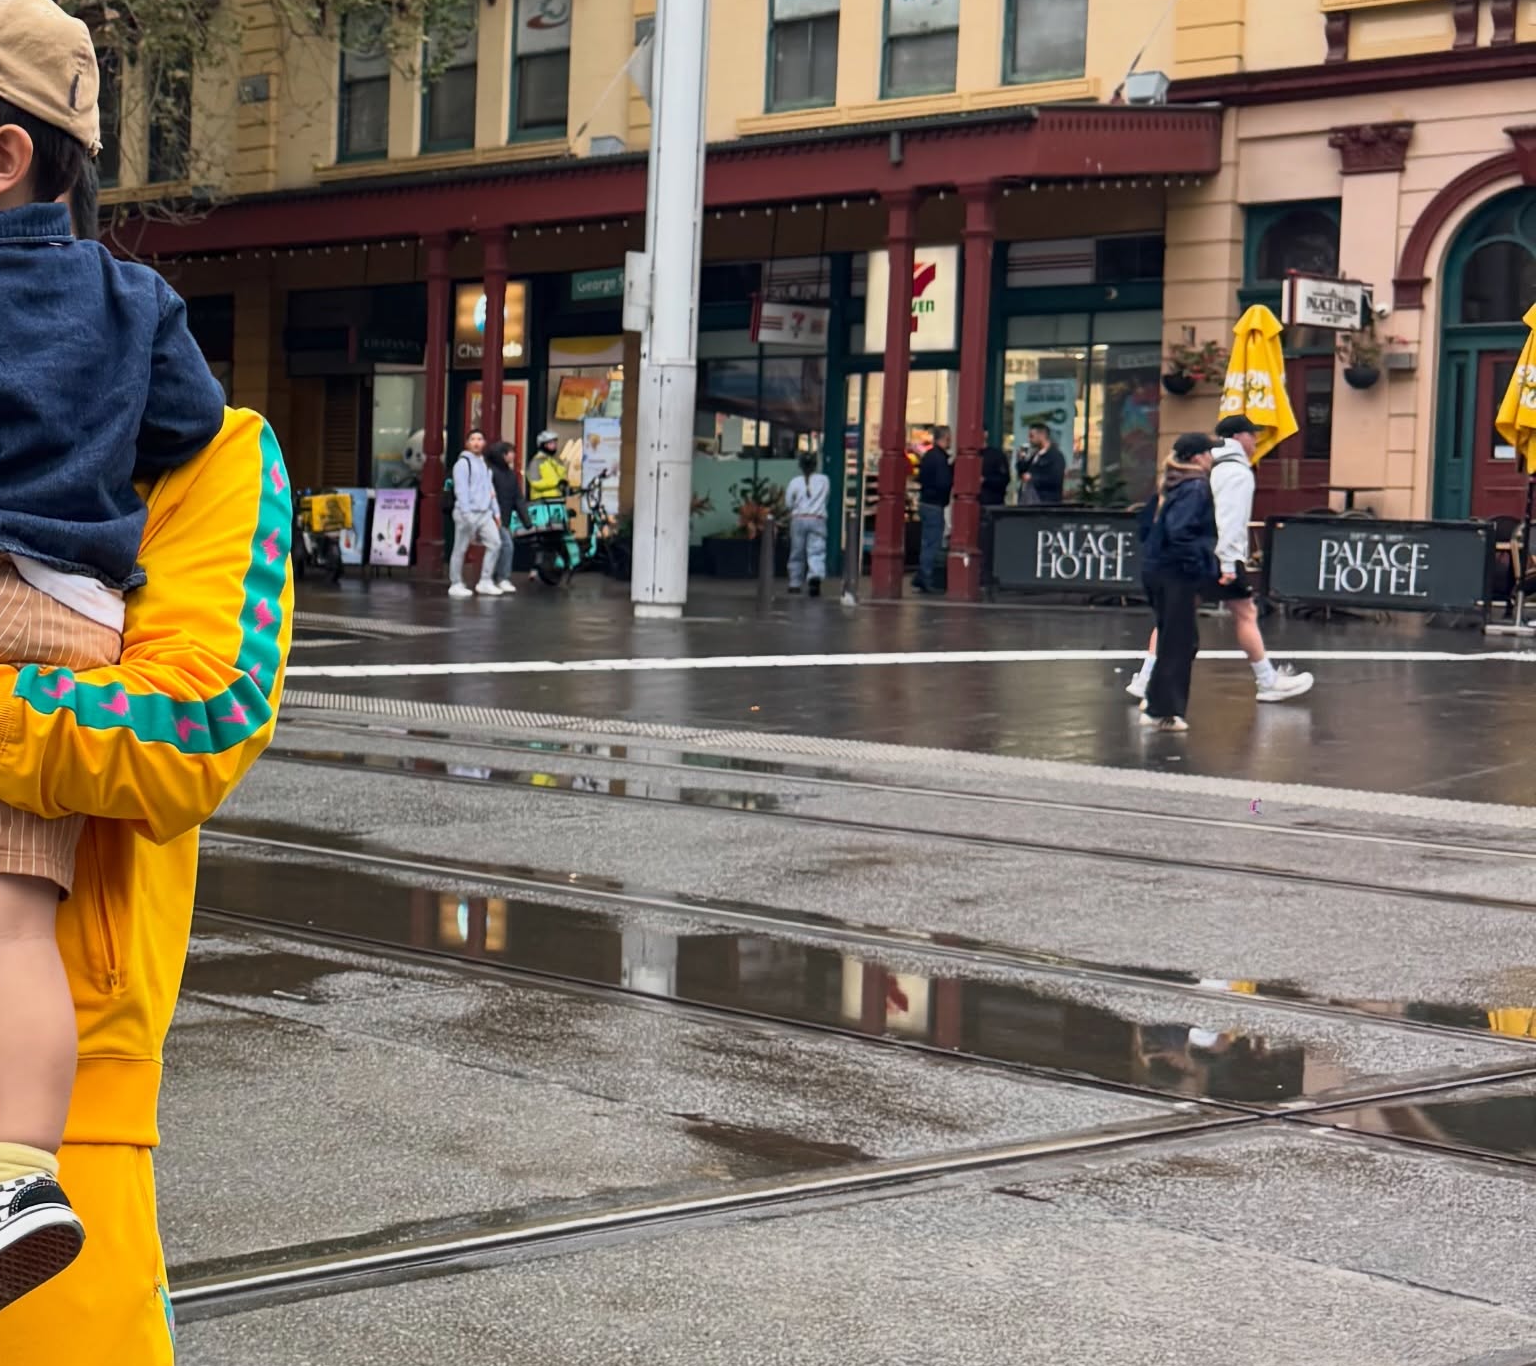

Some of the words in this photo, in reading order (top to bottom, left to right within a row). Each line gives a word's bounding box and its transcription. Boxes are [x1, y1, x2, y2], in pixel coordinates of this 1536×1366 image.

[577, 276, 617, 295] George
[1037, 530, 1135, 558] PALACE
[1320, 539, 1430, 571] PALACE
[1036, 553, 1133, 581] HOTEL
[1318, 563, 1428, 596] HOTEL
